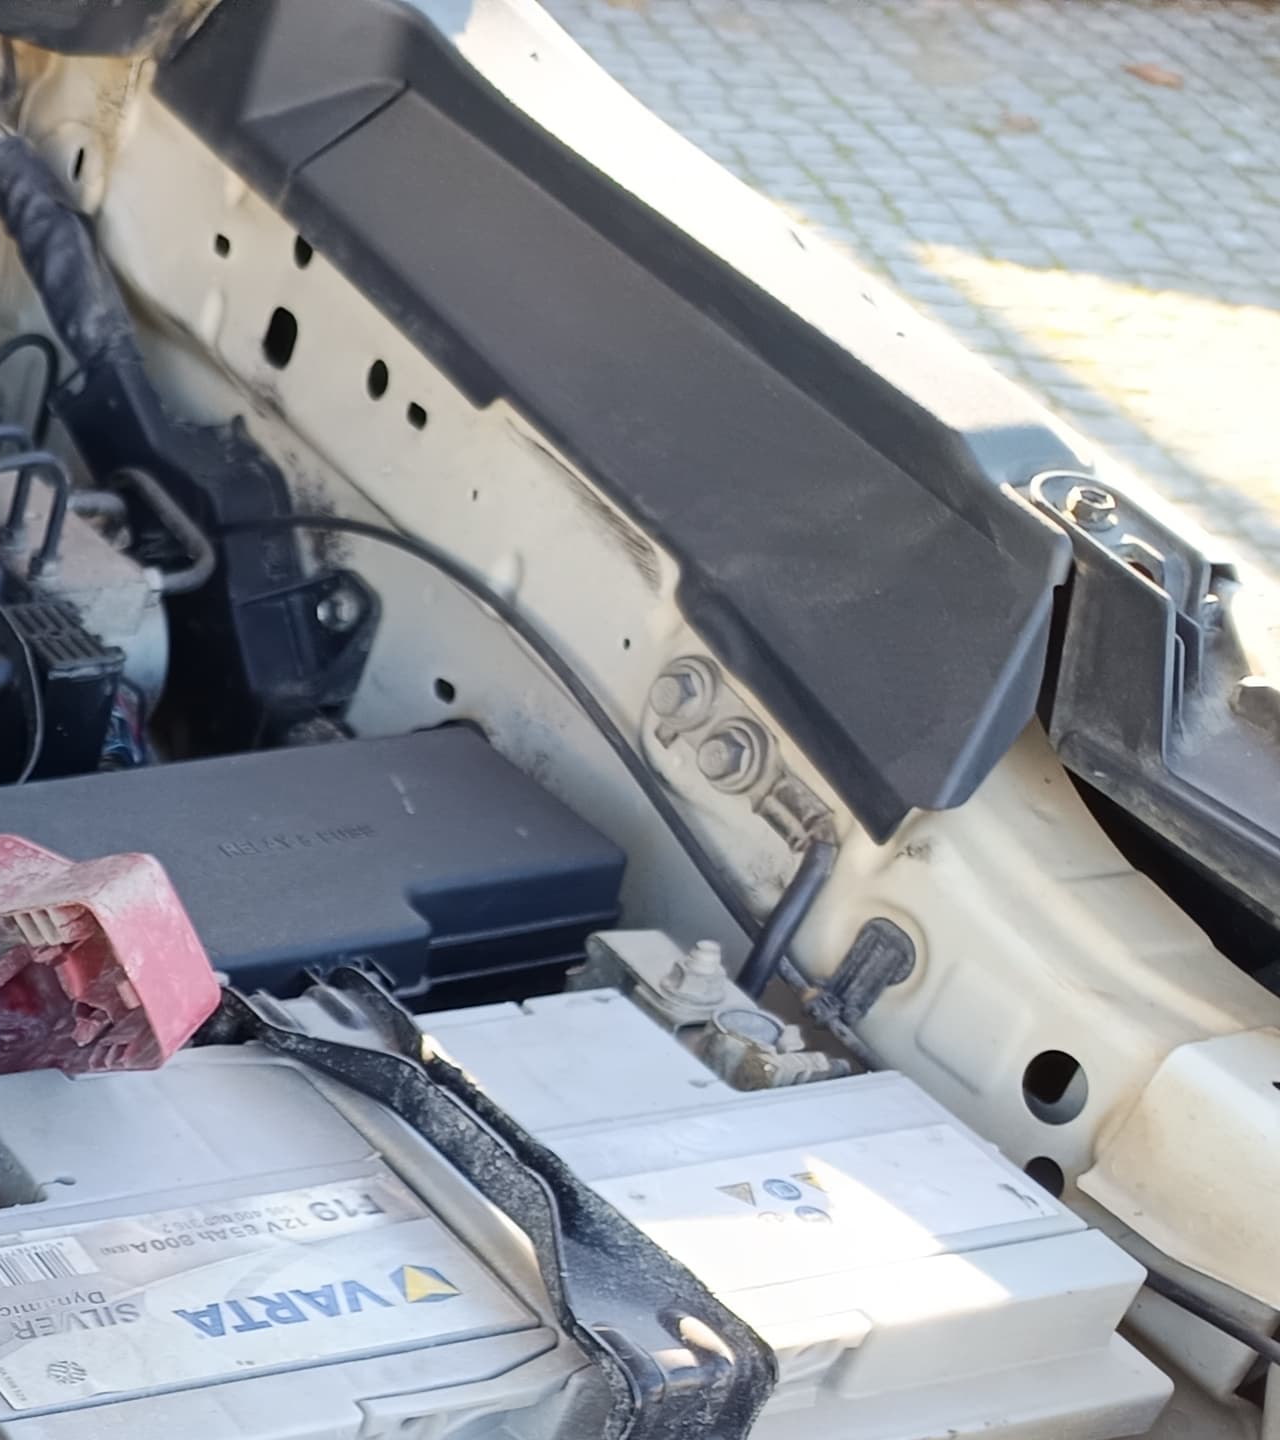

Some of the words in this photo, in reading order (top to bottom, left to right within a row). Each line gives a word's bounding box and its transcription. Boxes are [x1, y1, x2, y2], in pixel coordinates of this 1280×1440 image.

[267, 1217, 309, 1233] 12V
[308, 1188, 383, 1224] F19
[10, 1302, 143, 1342] SILVER
[173, 1280, 390, 1338] VARTA
